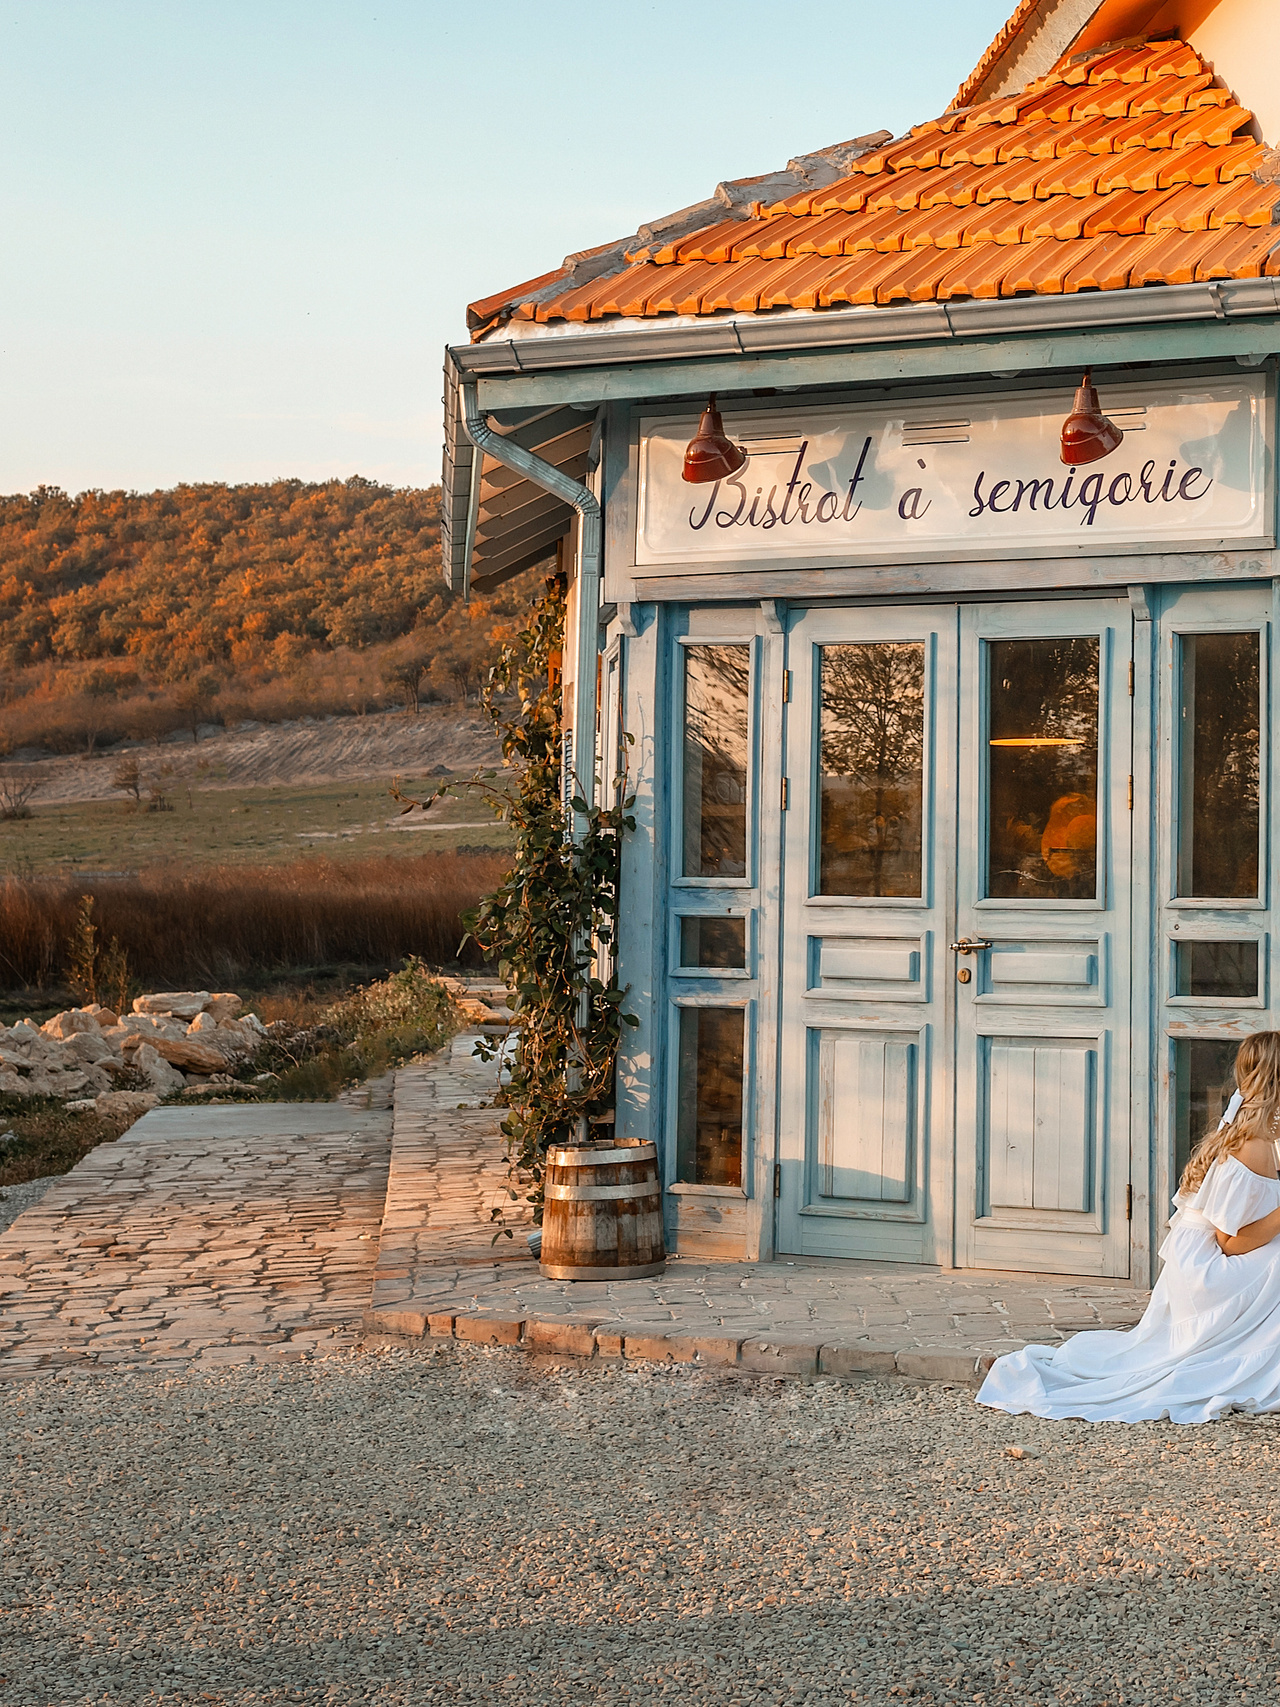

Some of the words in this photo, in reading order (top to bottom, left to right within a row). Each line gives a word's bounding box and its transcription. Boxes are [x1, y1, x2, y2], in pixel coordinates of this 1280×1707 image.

[689, 437, 873, 530] Bistrot
[898, 458, 932, 519] à
[968, 459, 1213, 525] semigorie
